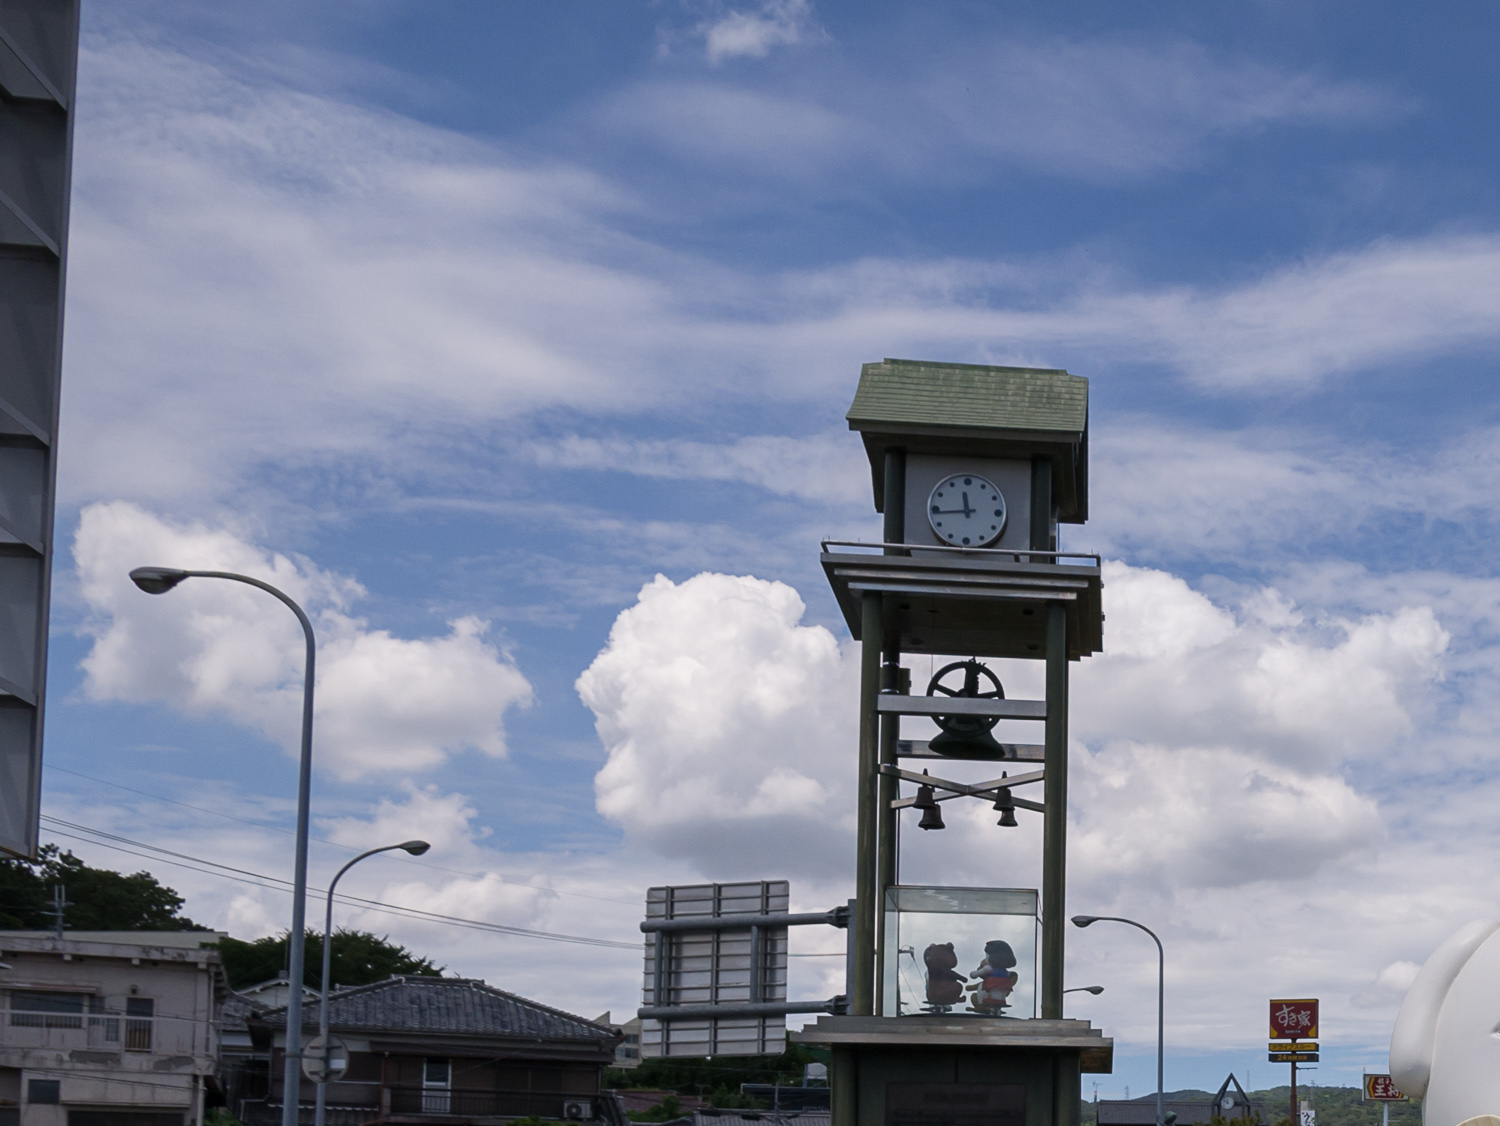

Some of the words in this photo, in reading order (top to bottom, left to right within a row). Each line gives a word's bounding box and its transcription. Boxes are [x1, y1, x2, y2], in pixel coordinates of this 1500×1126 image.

[1275, 1004, 1311, 1029] すき家
[1374, 1084, 1399, 1097] 王将
